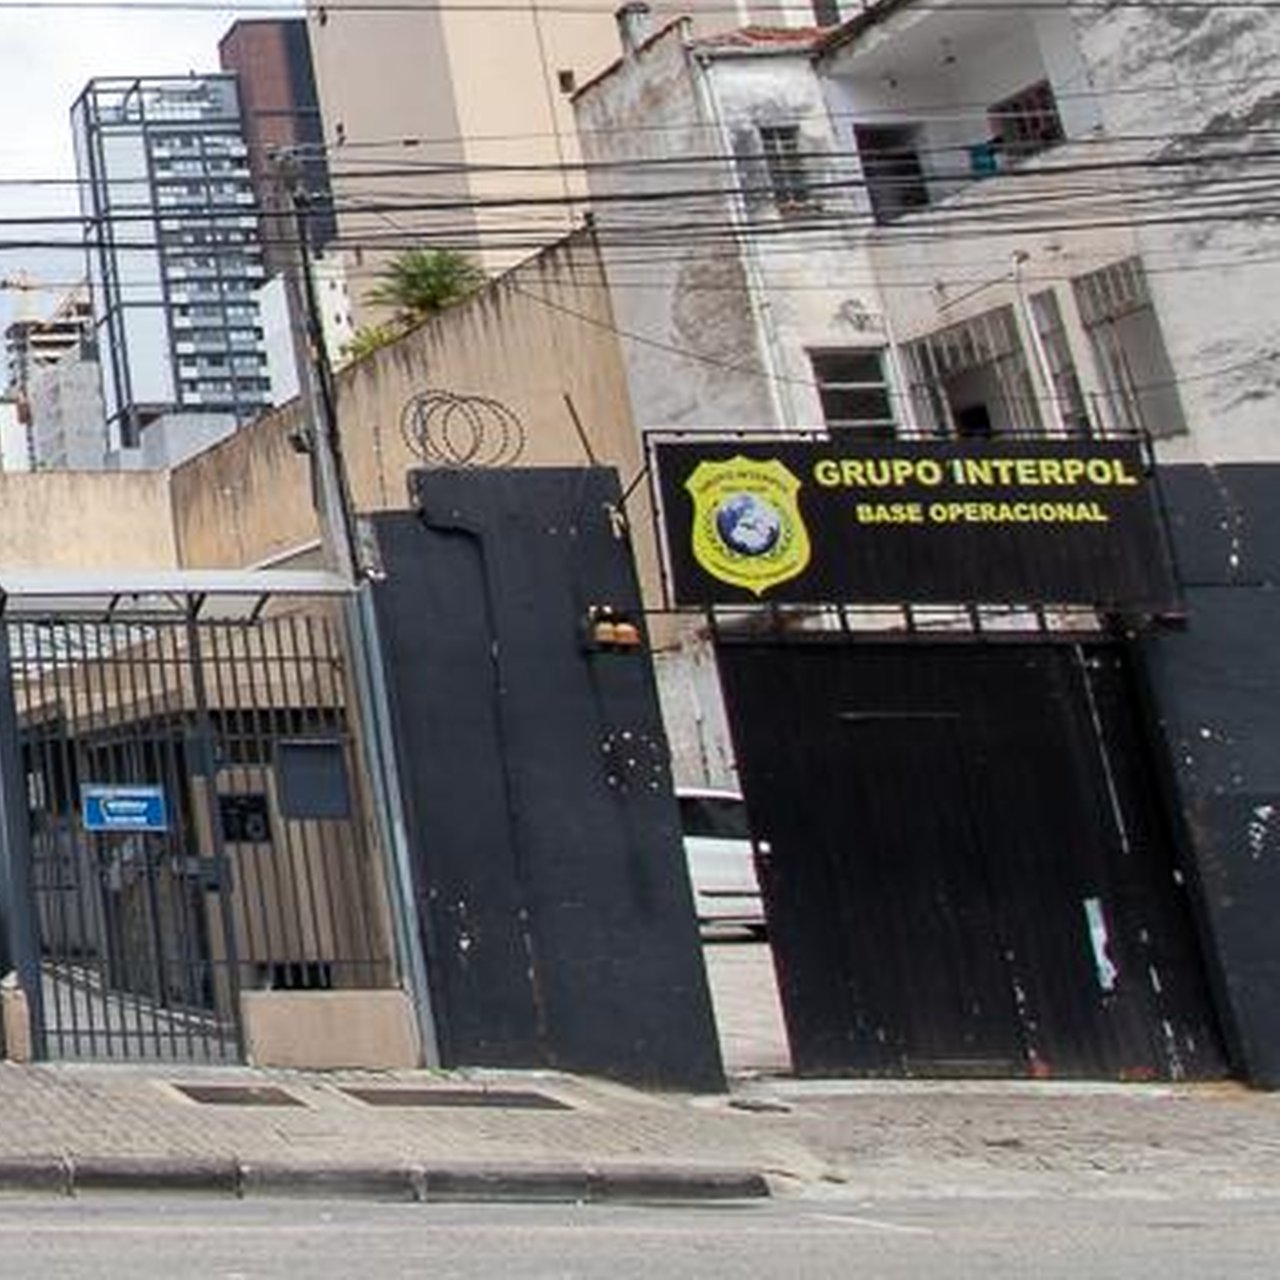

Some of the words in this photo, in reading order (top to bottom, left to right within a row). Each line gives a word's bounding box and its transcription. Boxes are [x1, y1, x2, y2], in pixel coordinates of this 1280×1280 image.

[814, 459, 941, 486] GRUPO
[952, 458, 1138, 486] INTERPOL
[855, 502, 924, 523] BASE
[929, 501, 1109, 522] OPERACIONAL
